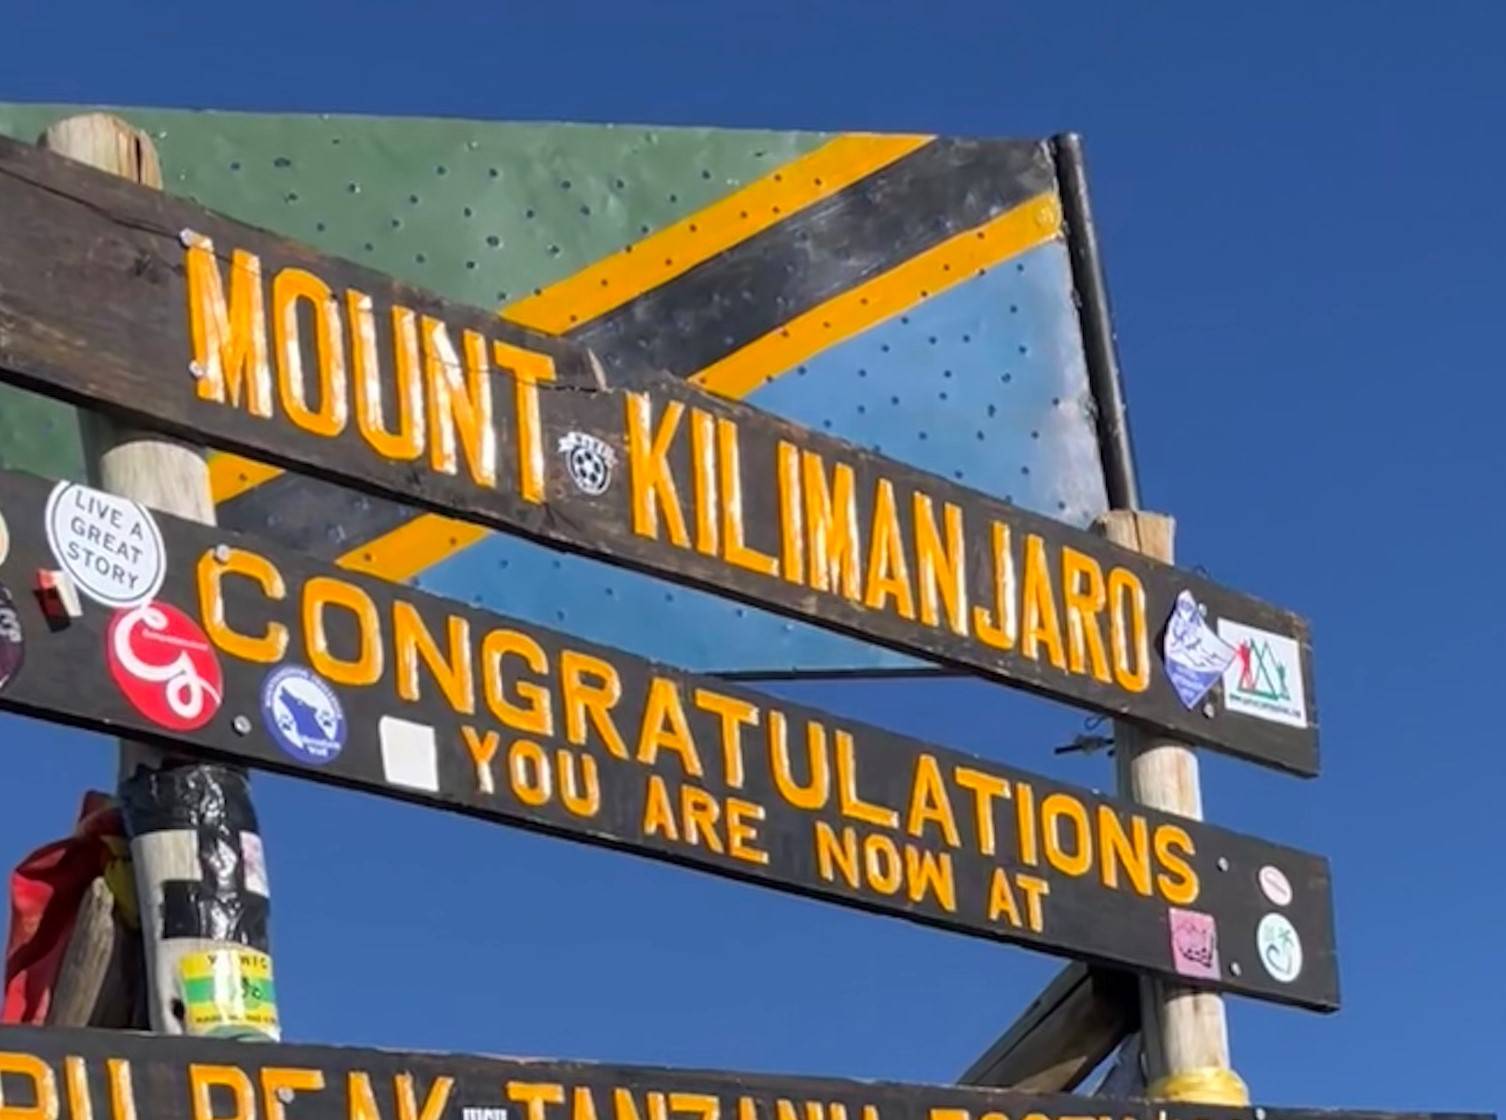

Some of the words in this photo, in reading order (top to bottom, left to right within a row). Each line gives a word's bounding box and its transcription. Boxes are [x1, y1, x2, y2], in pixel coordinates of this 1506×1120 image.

[74, 490, 122, 528] LIVE
[130, 522, 144, 540] A
[186, 233, 561, 507] MOUNT
[620, 391, 1151, 695] KILIMANJARO
[67, 541, 139, 590] STORY
[70, 516, 143, 564] GREAT
[193, 547, 1199, 907] CONGRATULATIONS
[459, 726, 600, 819] YOU
[643, 774, 768, 867] ARE
[815, 820, 957, 913] NOW
[987, 867, 1050, 933] AT
